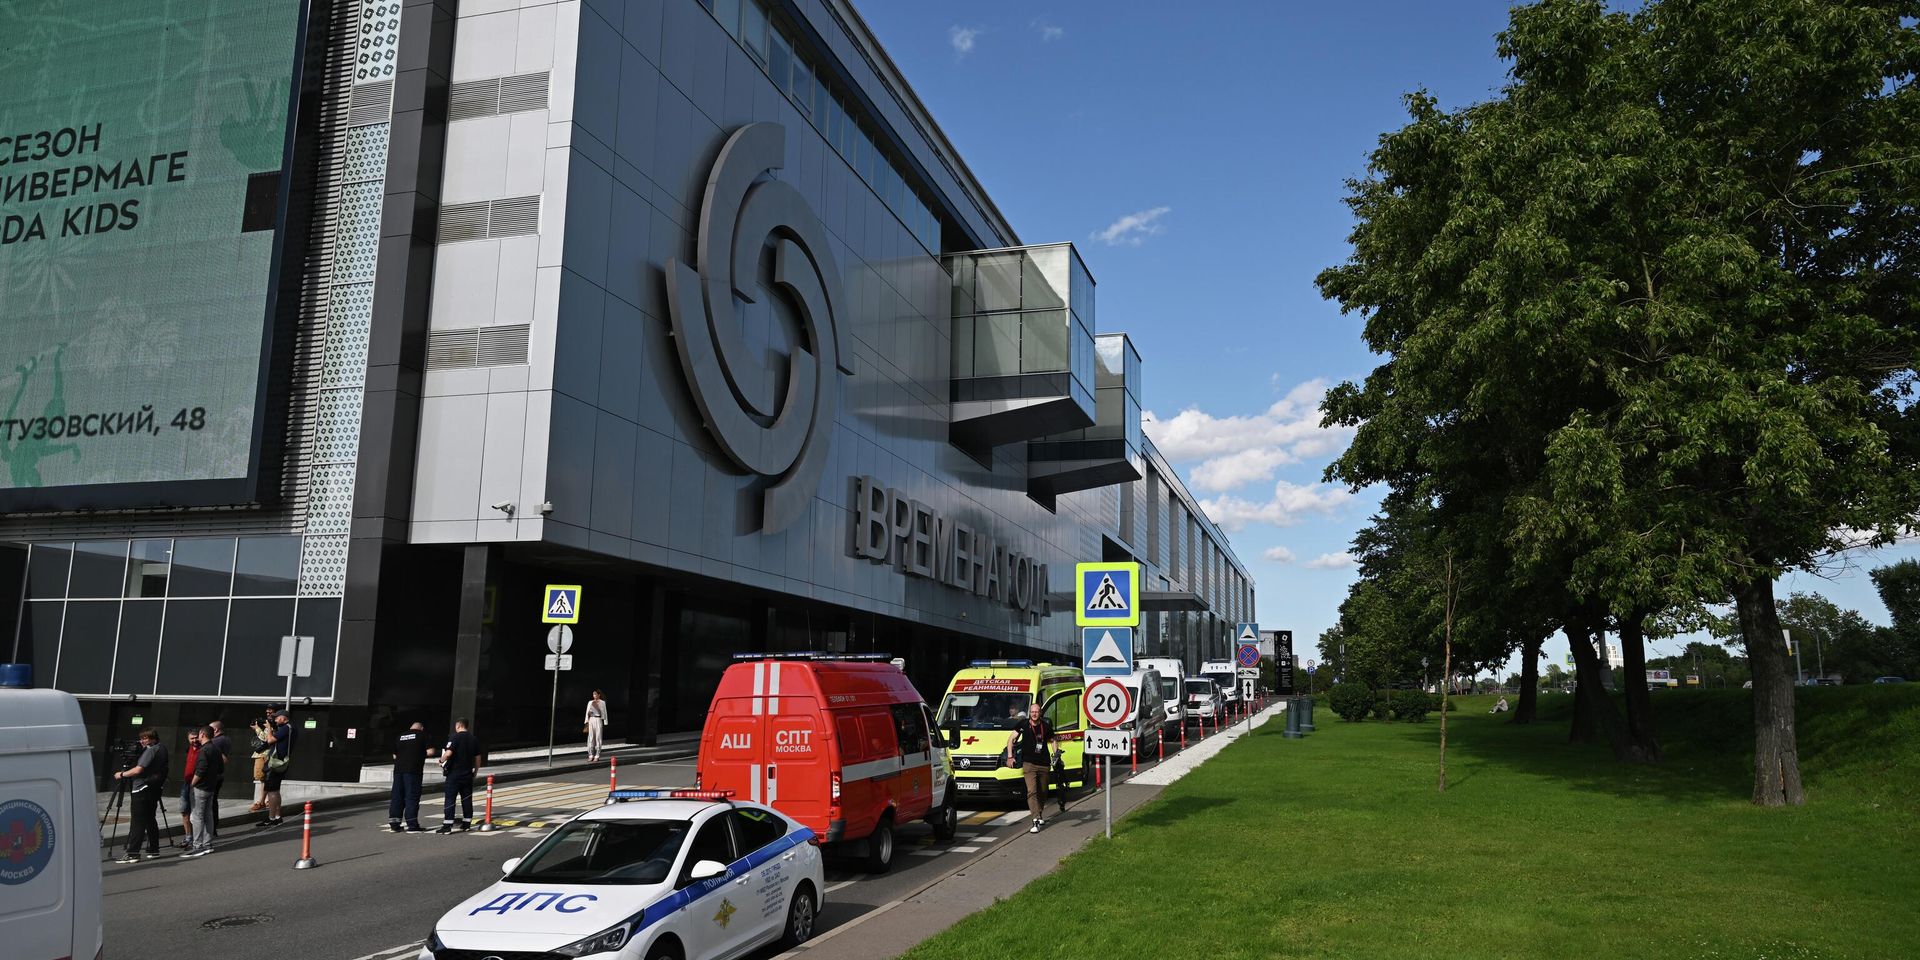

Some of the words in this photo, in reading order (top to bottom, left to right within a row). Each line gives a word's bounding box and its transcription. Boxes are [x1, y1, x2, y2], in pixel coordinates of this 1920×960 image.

[0, 151, 188, 205] ИВЕРМАГЕ
[0, 212, 46, 245] DA
[61, 199, 139, 237] KIDS
[170, 406, 206, 431] 48
[857, 475, 1001, 601] ВРЕМЕНА
[1001, 545, 1051, 626] ГОДА
[963, 684, 1019, 692] РЕАНИМАЦИЯ
[1093, 693, 1121, 713] 20
[720, 733, 751, 749] АШ
[776, 730, 812, 745] СПТ
[1097, 738, 1111, 749] 30
[775, 745, 812, 753] МОСКВА
[703, 868, 735, 891] ПОЛИЦИЯ
[468, 892, 598, 917] ДПС
